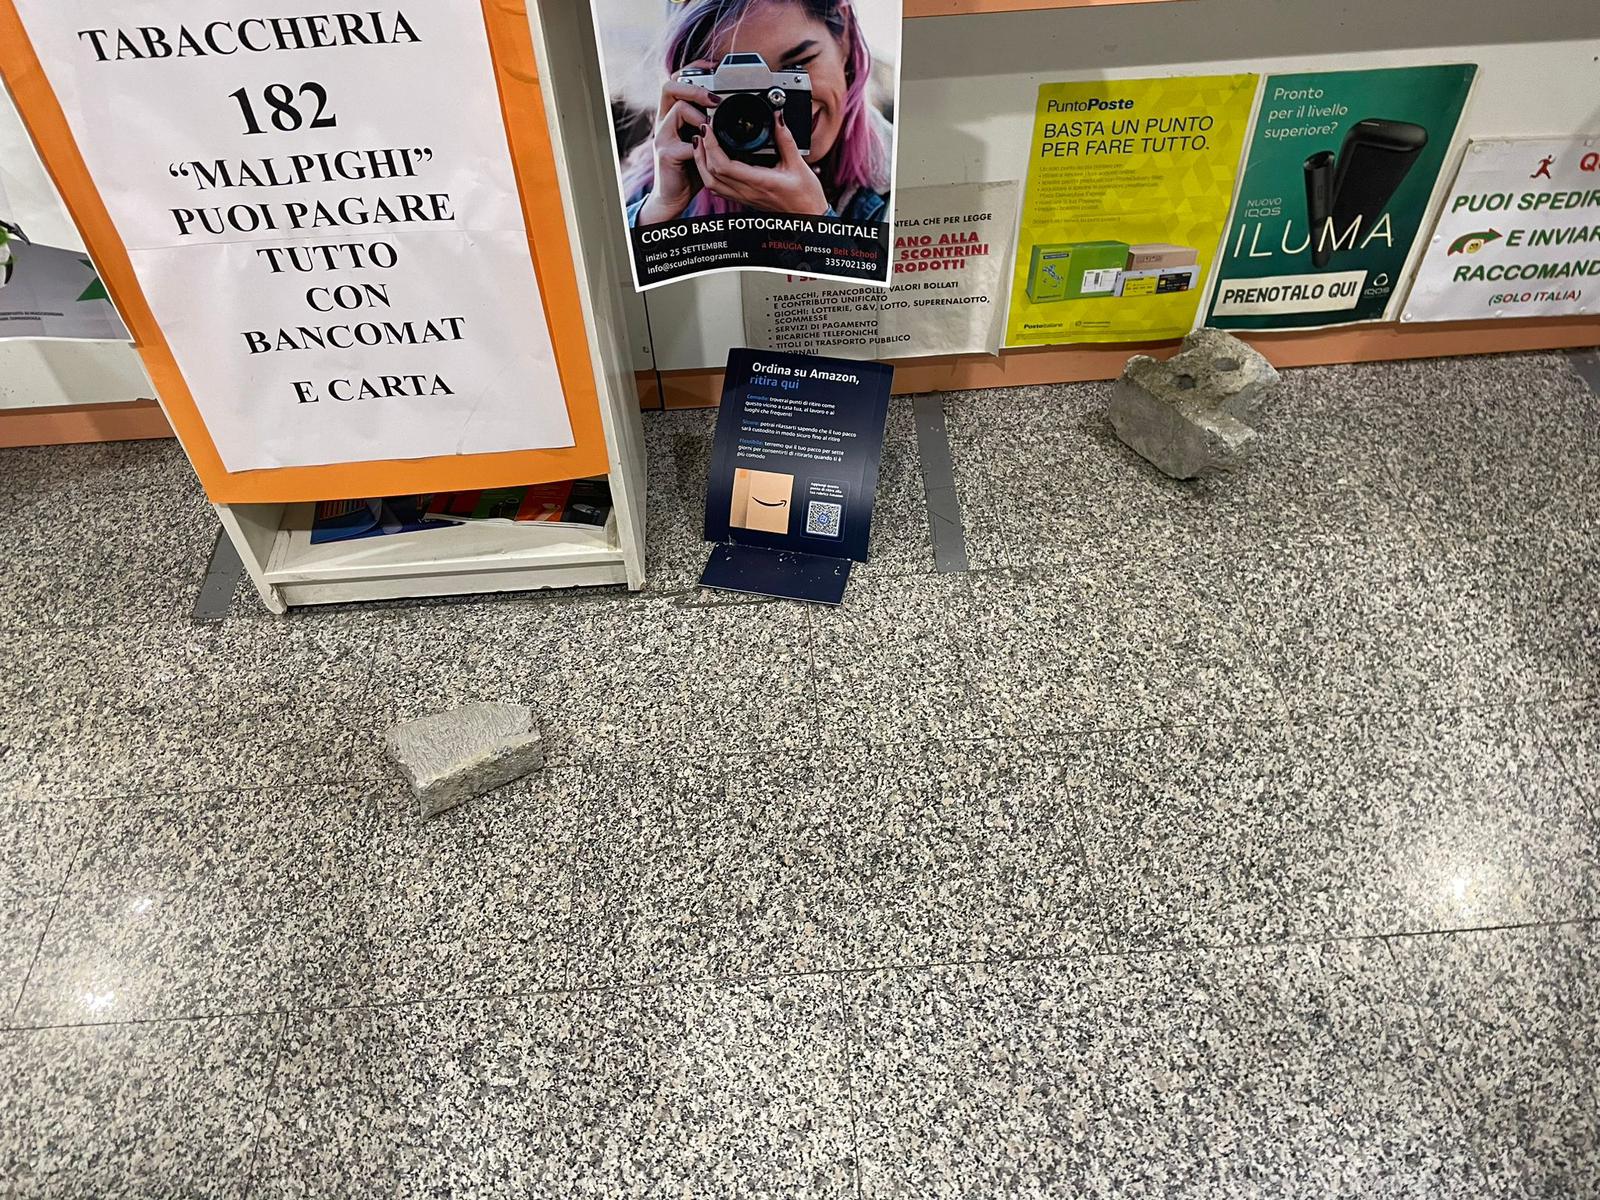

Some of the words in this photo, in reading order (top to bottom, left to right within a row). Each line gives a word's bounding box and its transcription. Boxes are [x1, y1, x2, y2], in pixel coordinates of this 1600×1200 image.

[78, 10, 422, 62] TABACCHERIA
[1273, 87, 1324, 101] Pronto
[228, 81, 338, 136] 182
[1047, 98, 1134, 113] PuntoPoste
[1267, 108, 1294, 123] per
[1296, 105, 1305, 119] il
[1307, 103, 1348, 118] livello
[1044, 120, 1105, 139] BASTA
[1111, 118, 1140, 135] UN
[1145, 115, 1214, 134] PUNTO
[1264, 122, 1339, 141] superiore?
[1041, 141, 1079, 158] PER
[1085, 138, 1135, 155] FARE
[1141, 135, 1210, 153] TUTTO.
[1580, 152, 1600, 172] Q
[1247, 197, 1282, 207] NUOVO
[1451, 192, 1514, 214] PUOI
[1517, 189, 1600, 211] SPEDIR
[171, 203, 279, 236] PUOI
[287, 193, 456, 231] PAGARE
[923, 217, 941, 226] CHE
[943, 215, 960, 224] PER
[963, 212, 993, 222] LEGGE
[1244, 207, 1281, 218] IQOS
[641, 224, 688, 244] CORSO
[692, 220, 725, 234] BASE
[728, 218, 814, 233] FOTOGRAFIA
[818, 221, 878, 240] DIGITALE
[895, 235, 932, 248] ANO
[939, 231, 979, 245] ALLA
[1233, 213, 1393, 258] ILUMA
[1506, 229, 1525, 247] E
[1527, 225, 1600, 247] INVIAR
[256, 241, 399, 274] TUTTO
[645, 251, 668, 263] inizio
[670, 248, 680, 257] 25
[682, 241, 729, 255] SETTEMBRE
[768, 241, 803, 251] PERUGIA
[804, 245, 832, 254] presso
[833, 247, 849, 256] Belt
[850, 249, 878, 259] School
[900, 244, 989, 260] SCONTRINI
[647, 251, 749, 275] info@scuolafotogrammi.it
[825, 258, 877, 271] 3357021369
[1453, 259, 1600, 282] RACCOMAND
[305, 283, 392, 313] CON
[773, 291, 819, 302] TABACCHI,
[821, 286, 886, 297] FRANCOBOLLI,
[889, 283, 921, 292] VALORI
[923, 281, 959, 290] BOLLATI
[781, 297, 838, 309] CONTRIBUTO
[841, 295, 888, 304] UNIFICATO
[1222, 283, 1324, 304] PRENOTALO
[1328, 281, 1358, 298] QUI
[1488, 291, 1532, 307] (SOLO
[1533, 289, 1582, 302] ITALIA)
[774, 308, 809, 318] GIOCHI:
[812, 305, 852, 314] LOTTERIE,
[855, 304, 878, 312] G&V,
[880, 301, 911, 310] LOTTO,
[913, 295, 990, 307] SUPERENALOTTO,
[775, 314, 828, 325] SCOMMESSE
[775, 324, 808, 333] SERVIZI
[822, 320, 878, 330] PAGAMENTO
[241, 317, 466, 354] BANCOMAT
[776, 331, 820, 341] RICARICHE
[823, 328, 879, 338] TELEFONICHE
[776, 341, 801, 349] TITOLI
[816, 337, 867, 346] TRASPORTO
[869, 334, 911, 344] PUBBLICO
[749, 374, 778, 387] ritira
[780, 379, 800, 390] qui
[752, 362, 792, 376] Ordina
[793, 368, 807, 377] su
[809, 368, 860, 385] Amazon,
[290, 380, 320, 405] E
[328, 374, 455, 402] CARTA
